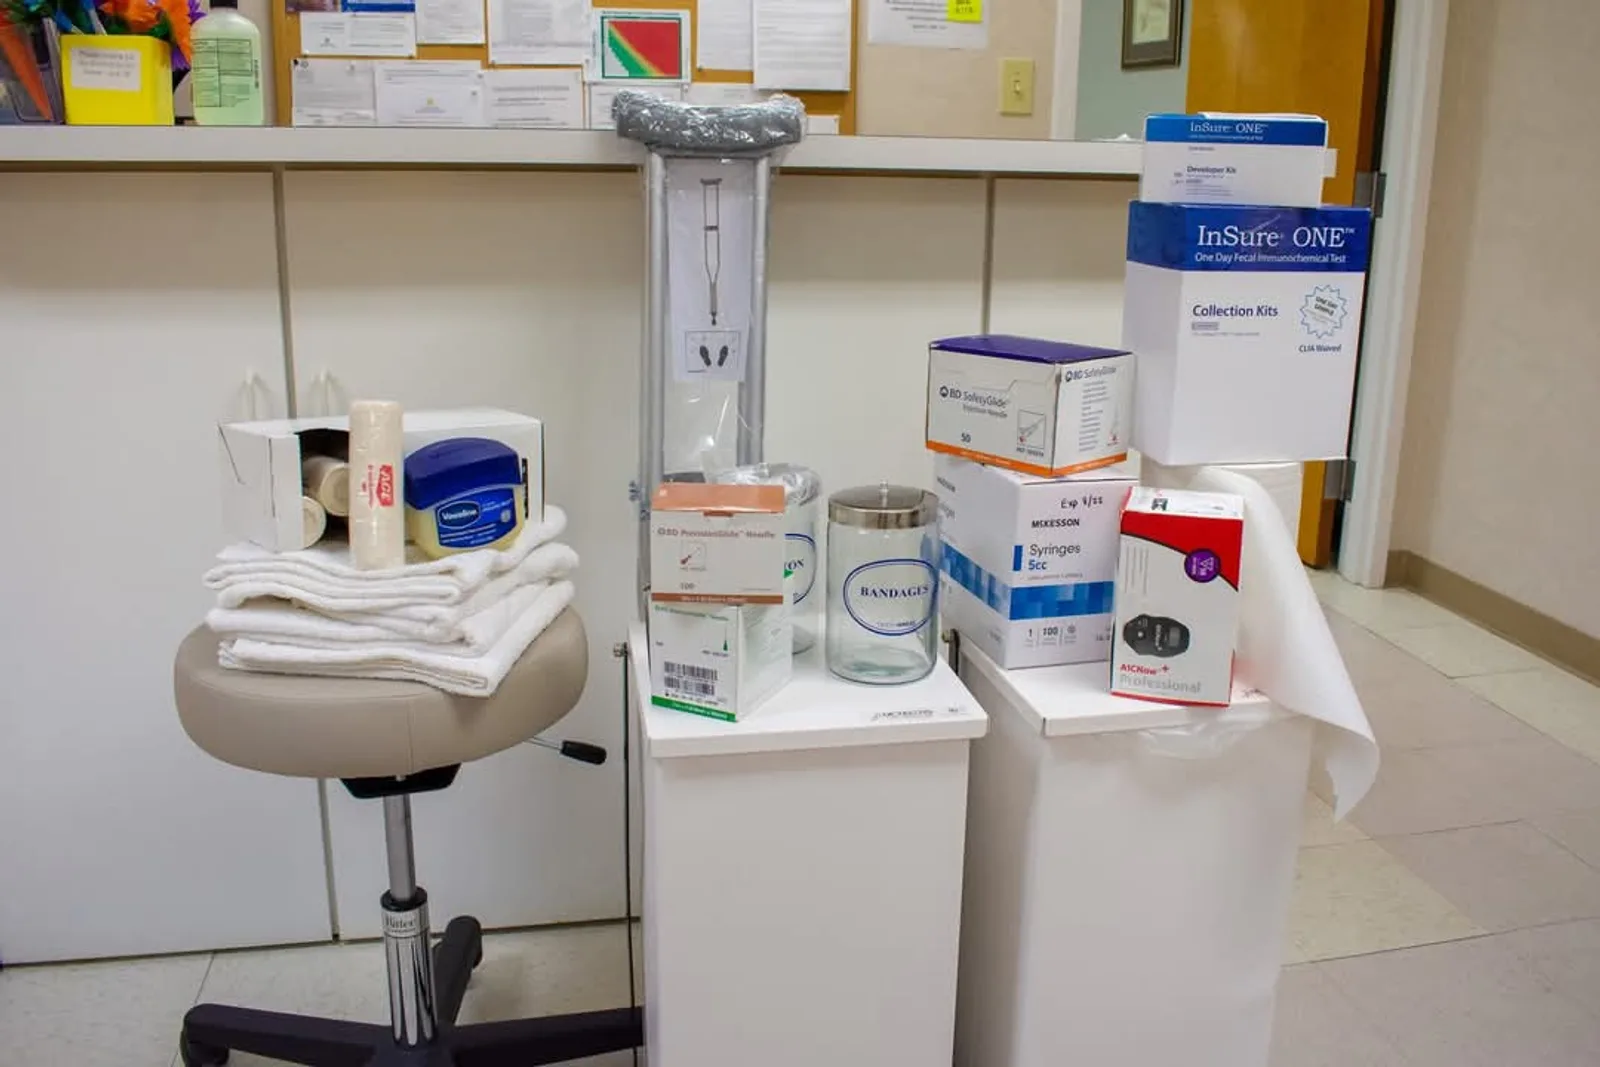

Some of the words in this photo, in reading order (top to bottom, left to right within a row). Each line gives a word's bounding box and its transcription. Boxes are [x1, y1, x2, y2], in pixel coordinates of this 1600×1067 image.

[1194, 251, 1214, 263] One
[1215, 252, 1233, 265] Day
[1234, 253, 1256, 263] Fecal
[1257, 253, 1329, 264] Immunochemical
[1330, 253, 1347, 264] Test
[1192, 304, 1253, 318] Collection
[1256, 304, 1279, 318] Kits
[961, 432, 972, 443] 50
[1060, 498, 1079, 509] Exp
[1029, 543, 1082, 558] Syringes
[1028, 559, 1048, 571] 5cc
[860, 586, 929, 599] BANDAGES
[1120, 675, 1202, 694] Professional
